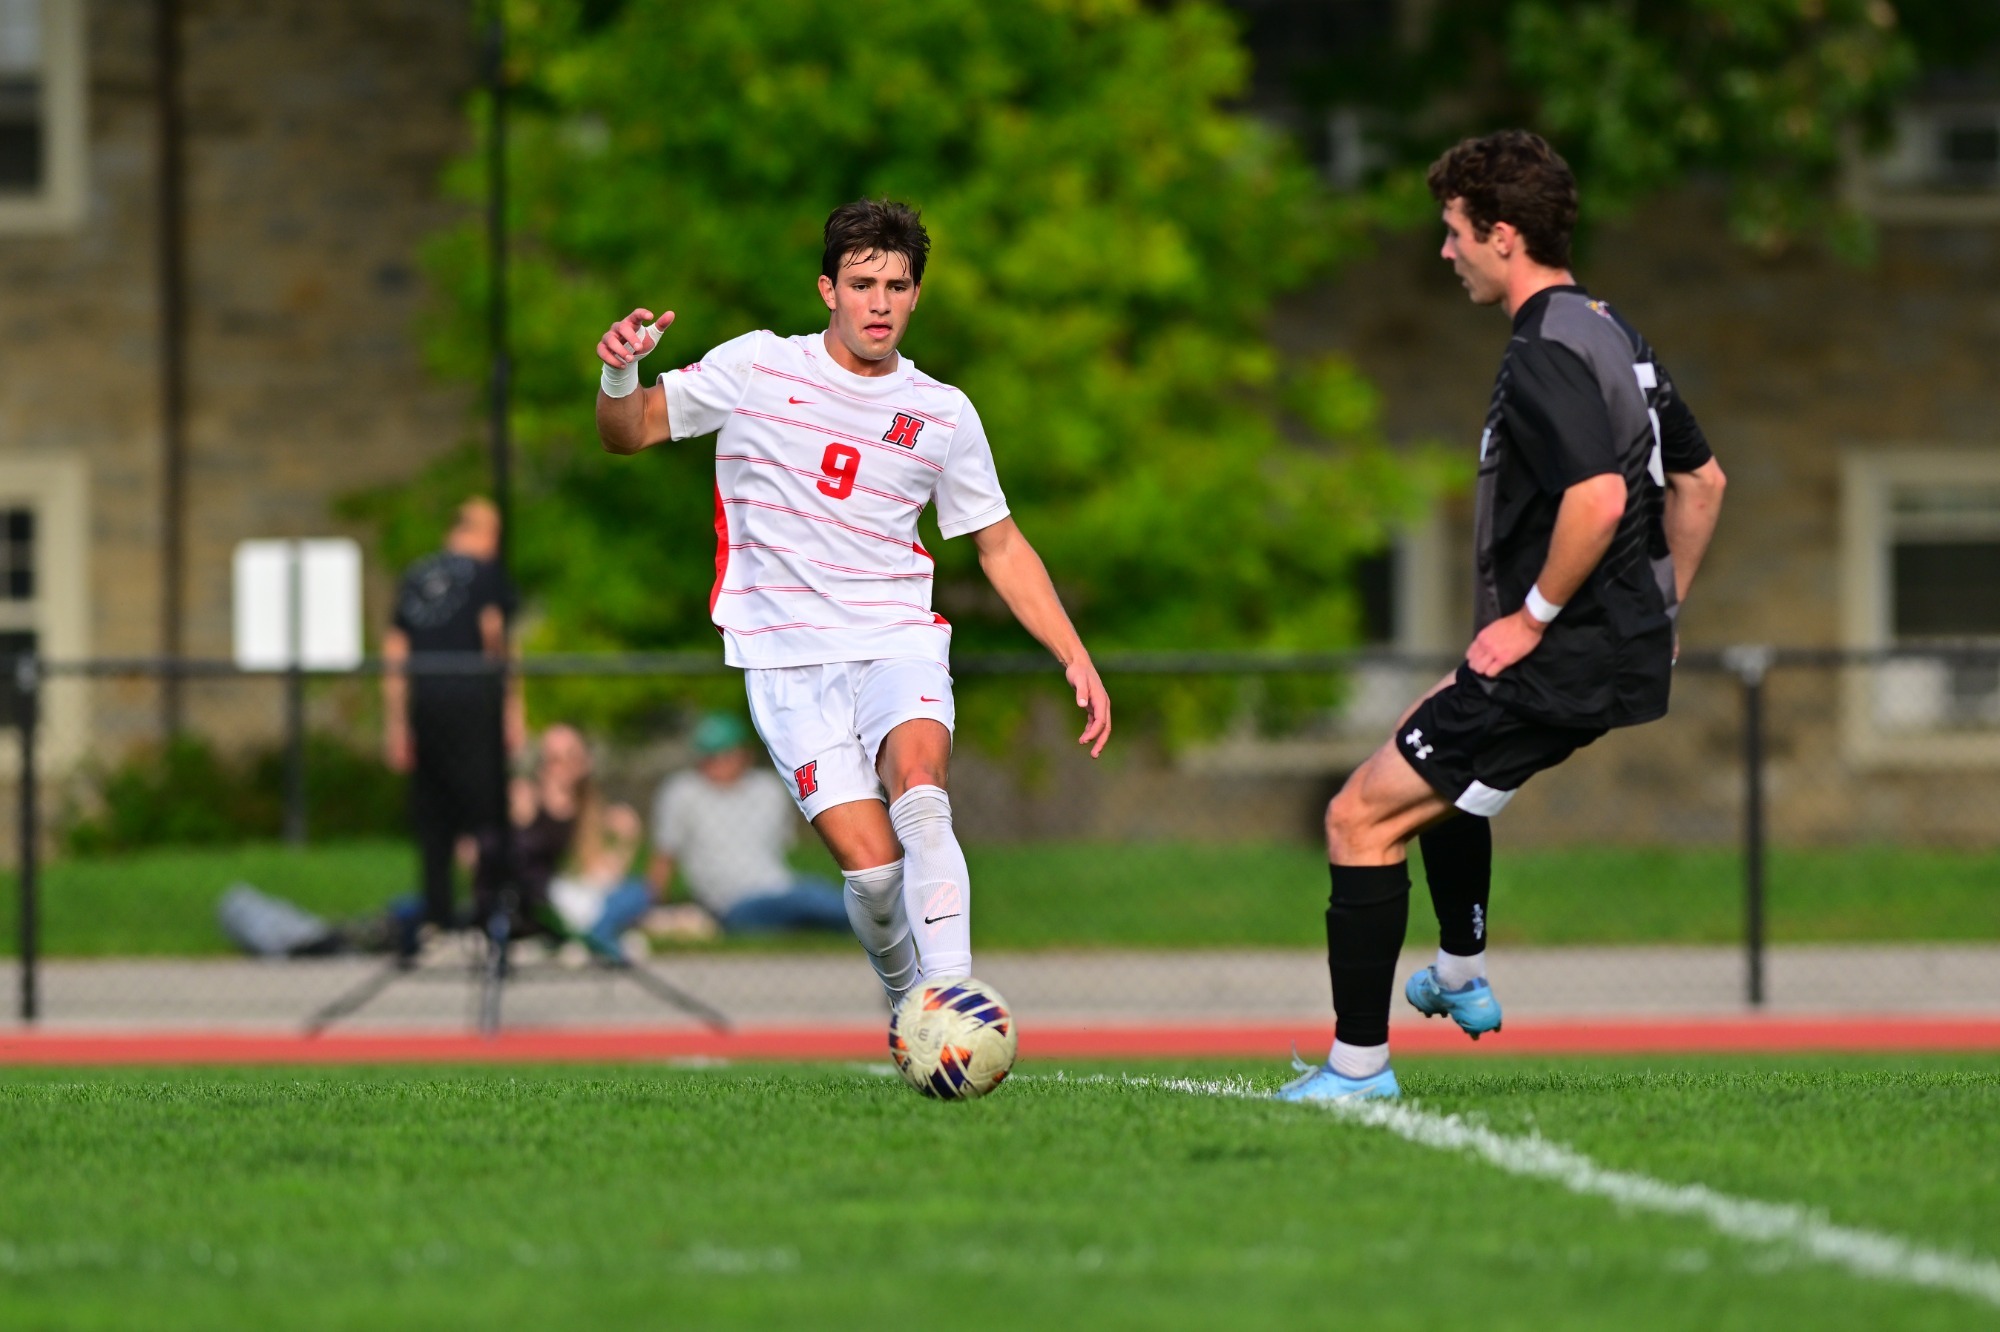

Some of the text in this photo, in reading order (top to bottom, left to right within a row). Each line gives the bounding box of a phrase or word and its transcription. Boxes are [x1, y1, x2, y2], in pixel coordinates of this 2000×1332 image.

[882, 412, 924, 450] H
[816, 442, 861, 501] 9
[794, 759, 818, 802] H
